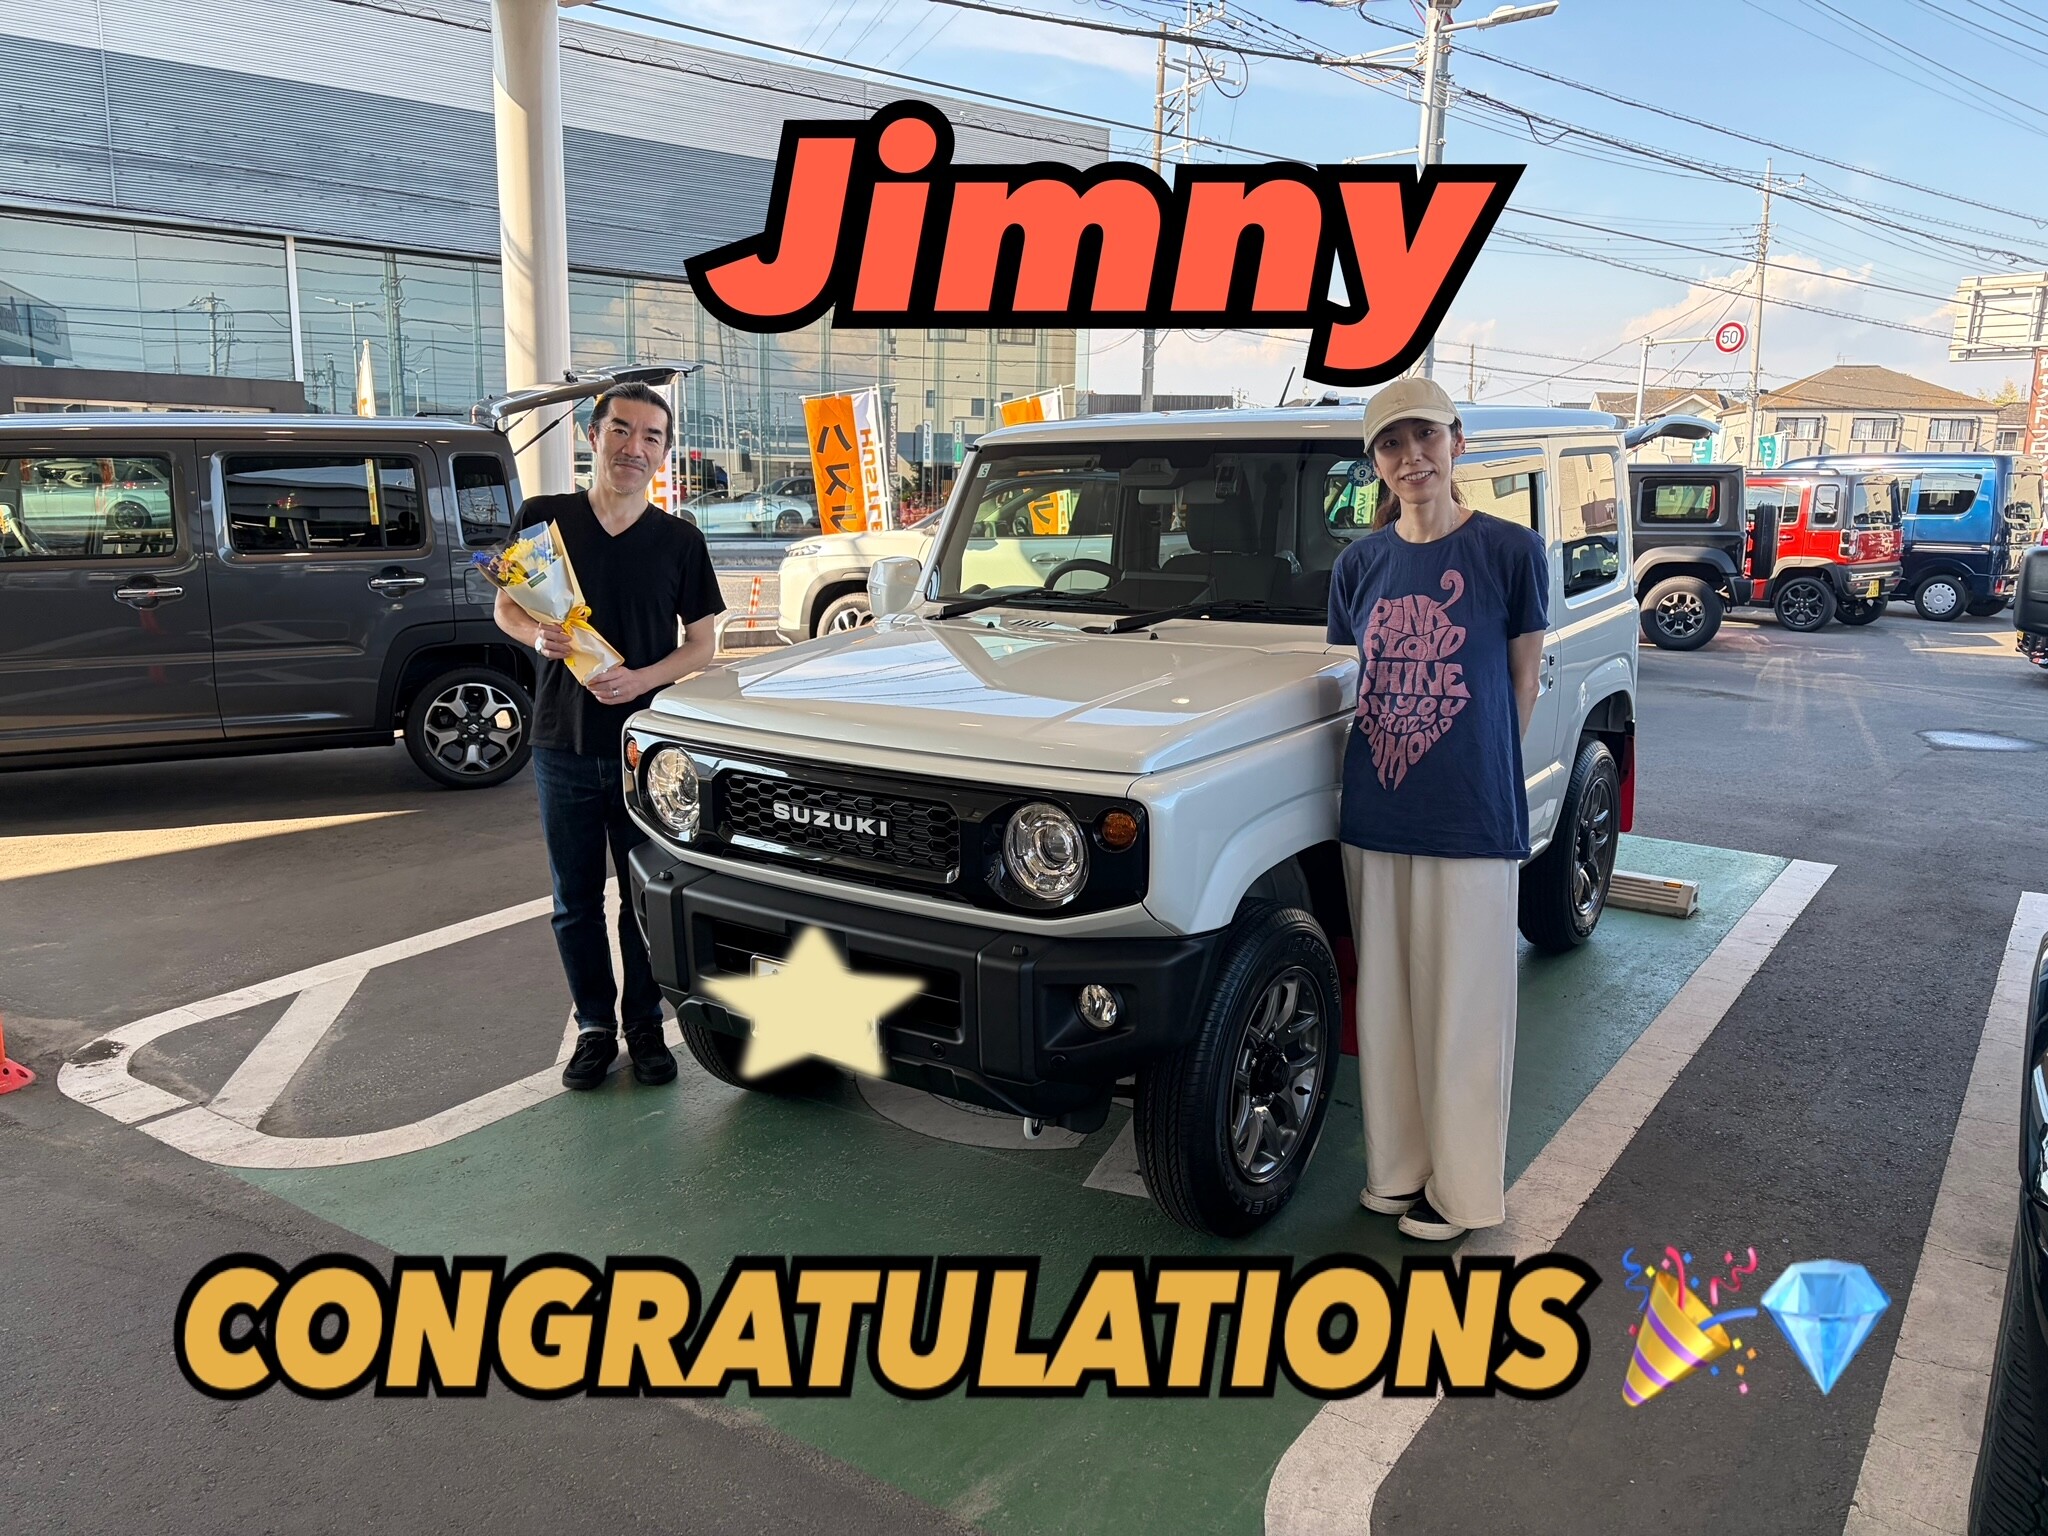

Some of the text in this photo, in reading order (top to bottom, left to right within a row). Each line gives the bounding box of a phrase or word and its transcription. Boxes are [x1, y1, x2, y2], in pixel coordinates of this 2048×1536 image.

[1721, 330, 1738, 345] 50
[1363, 625, 1466, 661] FLOYD
[1358, 660, 1472, 698] SHINE
[1378, 712, 1437, 734] CRAZY
[1393, 696, 1467, 717] YOU
[1359, 715, 1453, 791] DIAMOND
[772, 802, 888, 837] SUZUKI
